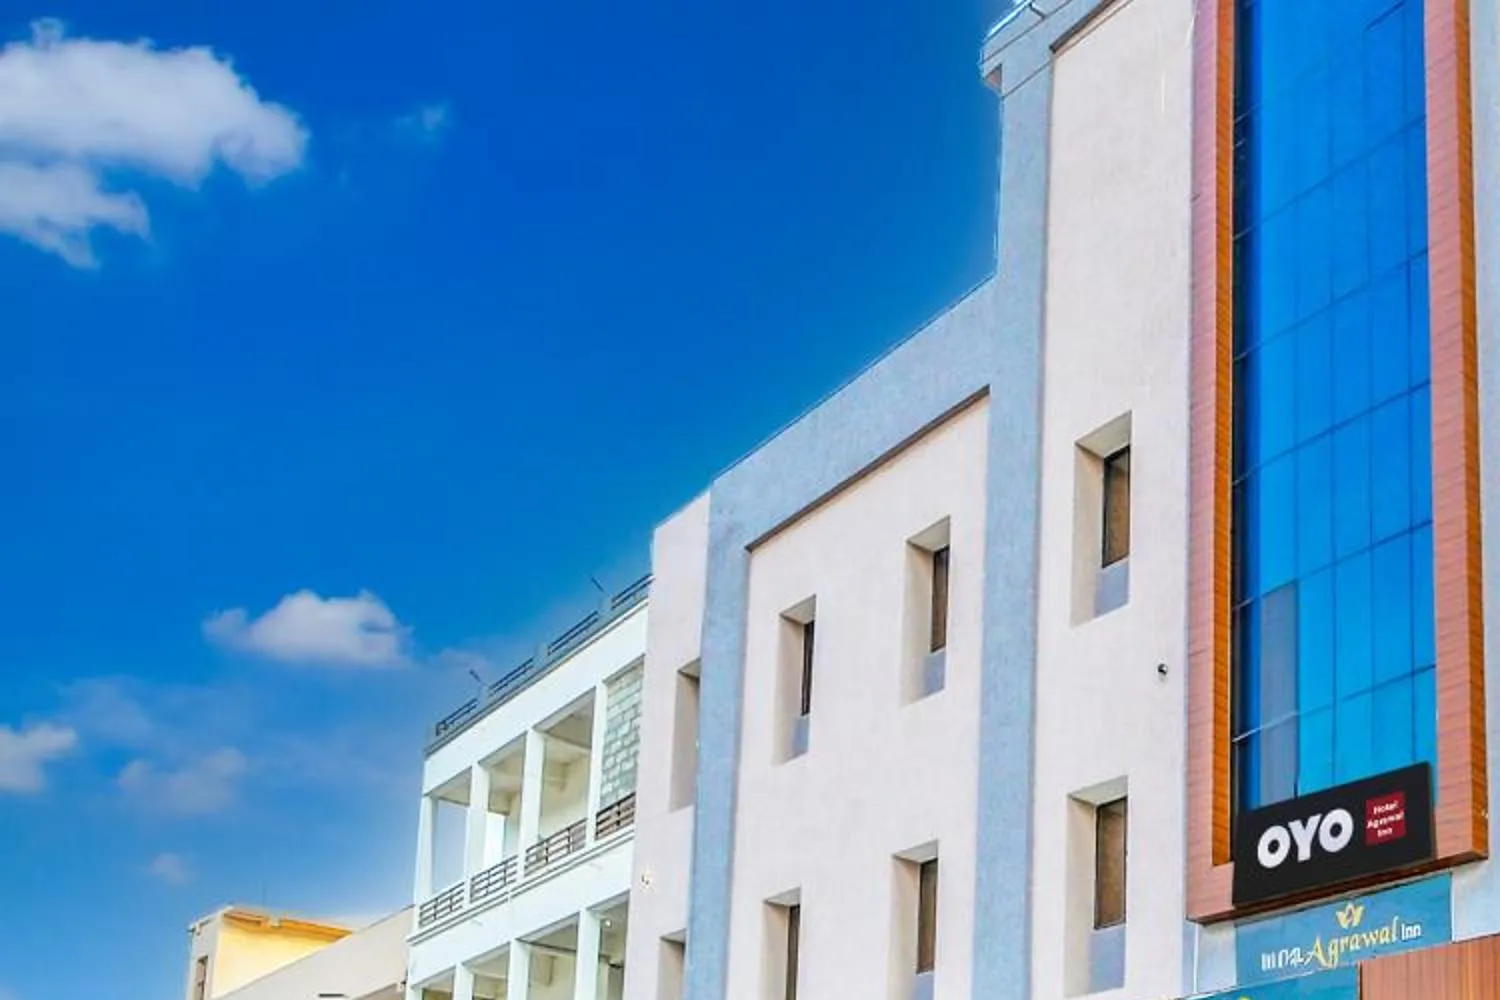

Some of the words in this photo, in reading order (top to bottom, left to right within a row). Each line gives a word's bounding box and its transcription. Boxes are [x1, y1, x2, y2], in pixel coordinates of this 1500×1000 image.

[1373, 801, 1398, 815] Hotel
[1257, 808, 1354, 869] OYO
[1377, 827, 1393, 837] Inn
[1305, 916, 1399, 969] Agrawal
[1401, 922, 1421, 940] Inn
